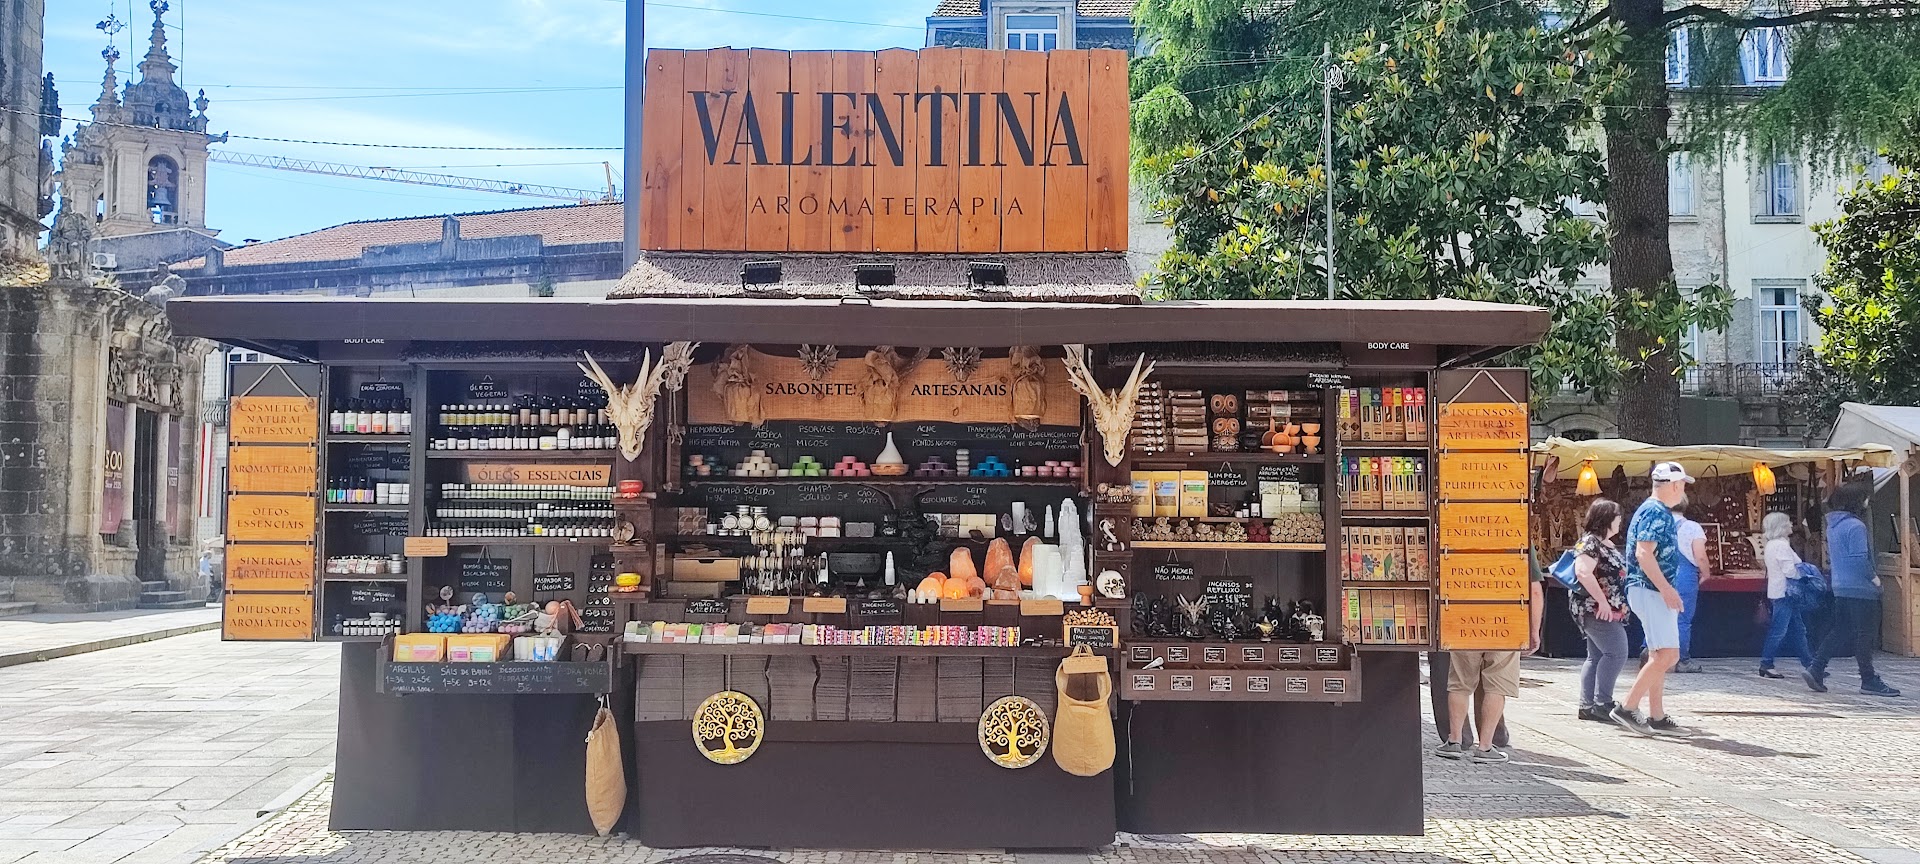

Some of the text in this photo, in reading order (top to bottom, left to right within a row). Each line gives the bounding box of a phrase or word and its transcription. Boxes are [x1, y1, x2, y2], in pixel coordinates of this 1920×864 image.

[687, 90, 1089, 168] VALENTINA
[751, 195, 1025, 216] AROMATERAPIA
[1367, 342, 1410, 350] BODY CARE
[469, 383, 494, 391] ÓLEOS
[579, 380, 602, 388] ÓLEO
[911, 383, 1008, 397] ARTESANAIS
[1452, 408, 1514, 417] INCENSOS
[246, 415, 301, 424] NATURAL
[1453, 420, 1515, 429] NATURAIS
[240, 426, 307, 435] ARTESANAL
[1446, 431, 1522, 440] ARTESANAIS
[105, 449, 123, 471] 500
[231, 464, 314, 474] AROMATERAPIA
[1461, 462, 1509, 471] RITUAIS
[477, 467, 602, 481] ÓLEOS ESSENCIAIS
[966, 486, 988, 494] LEITE
[1445, 480, 1525, 491] PURIFICAÇÃO
[743, 485, 776, 496] SÓLIDO
[1458, 515, 1510, 524] LIMPEZA
[237, 520, 304, 529] ESSENCIAIS
[240, 557, 302, 566] SINERGIAS
[231, 568, 310, 579] TERAPÊUTICAS
[1154, 566, 1194, 575] NÃO MEXER
[1451, 566, 1516, 577] PROTEÇÃO
[1446, 578, 1522, 589] ENERGÉTICA
[237, 605, 301, 614] DIFUSORES
[1460, 616, 1509, 624] SAIS DE
[1460, 629, 1510, 638] BANHO
[392, 665, 426, 674] ARGILAS
[440, 667, 458, 676] SAIS
[471, 667, 493, 676] BANHO
[516, 682, 533, 692] 5€
